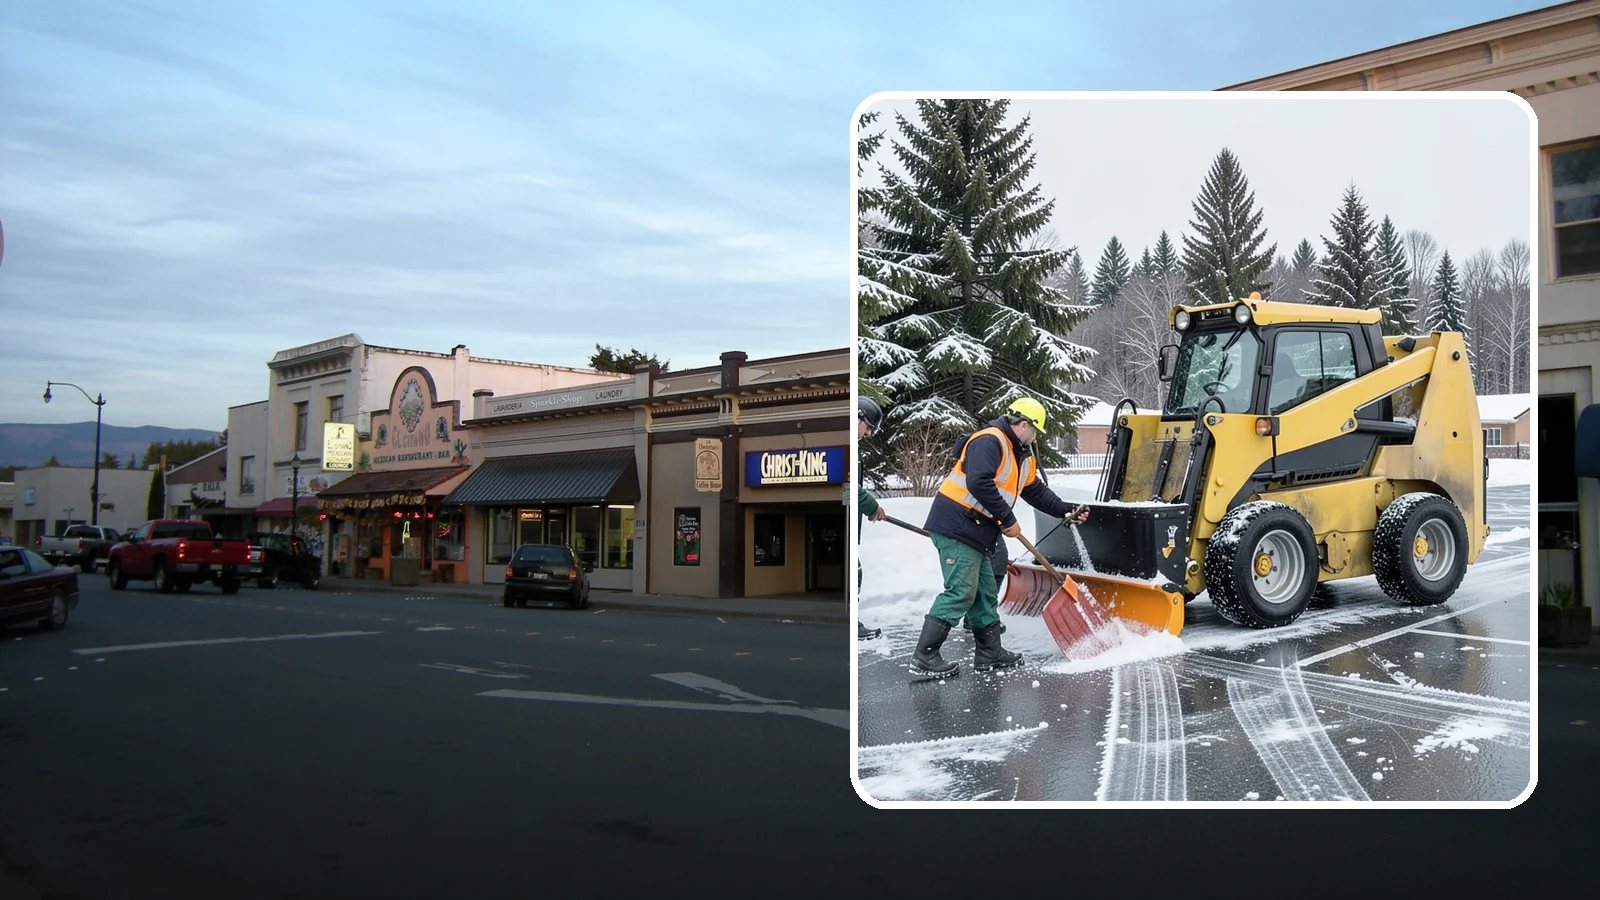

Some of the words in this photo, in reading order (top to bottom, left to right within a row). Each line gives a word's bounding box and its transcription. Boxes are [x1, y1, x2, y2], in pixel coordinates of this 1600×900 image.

[595, 389, 623, 400] LAUNDRY
[561, 395, 583, 405] Shop
[493, 402, 522, 412] LAVANDERIA
[373, 454, 396, 464] MEXICAN
[397, 451, 433, 462] RESTAURANT
[437, 450, 450, 459] BAR
[761, 452, 797, 478] CHRIST
[799, 450, 827, 476] KING
[697, 481, 709, 489] Coffee
[710, 481, 722, 489] House
